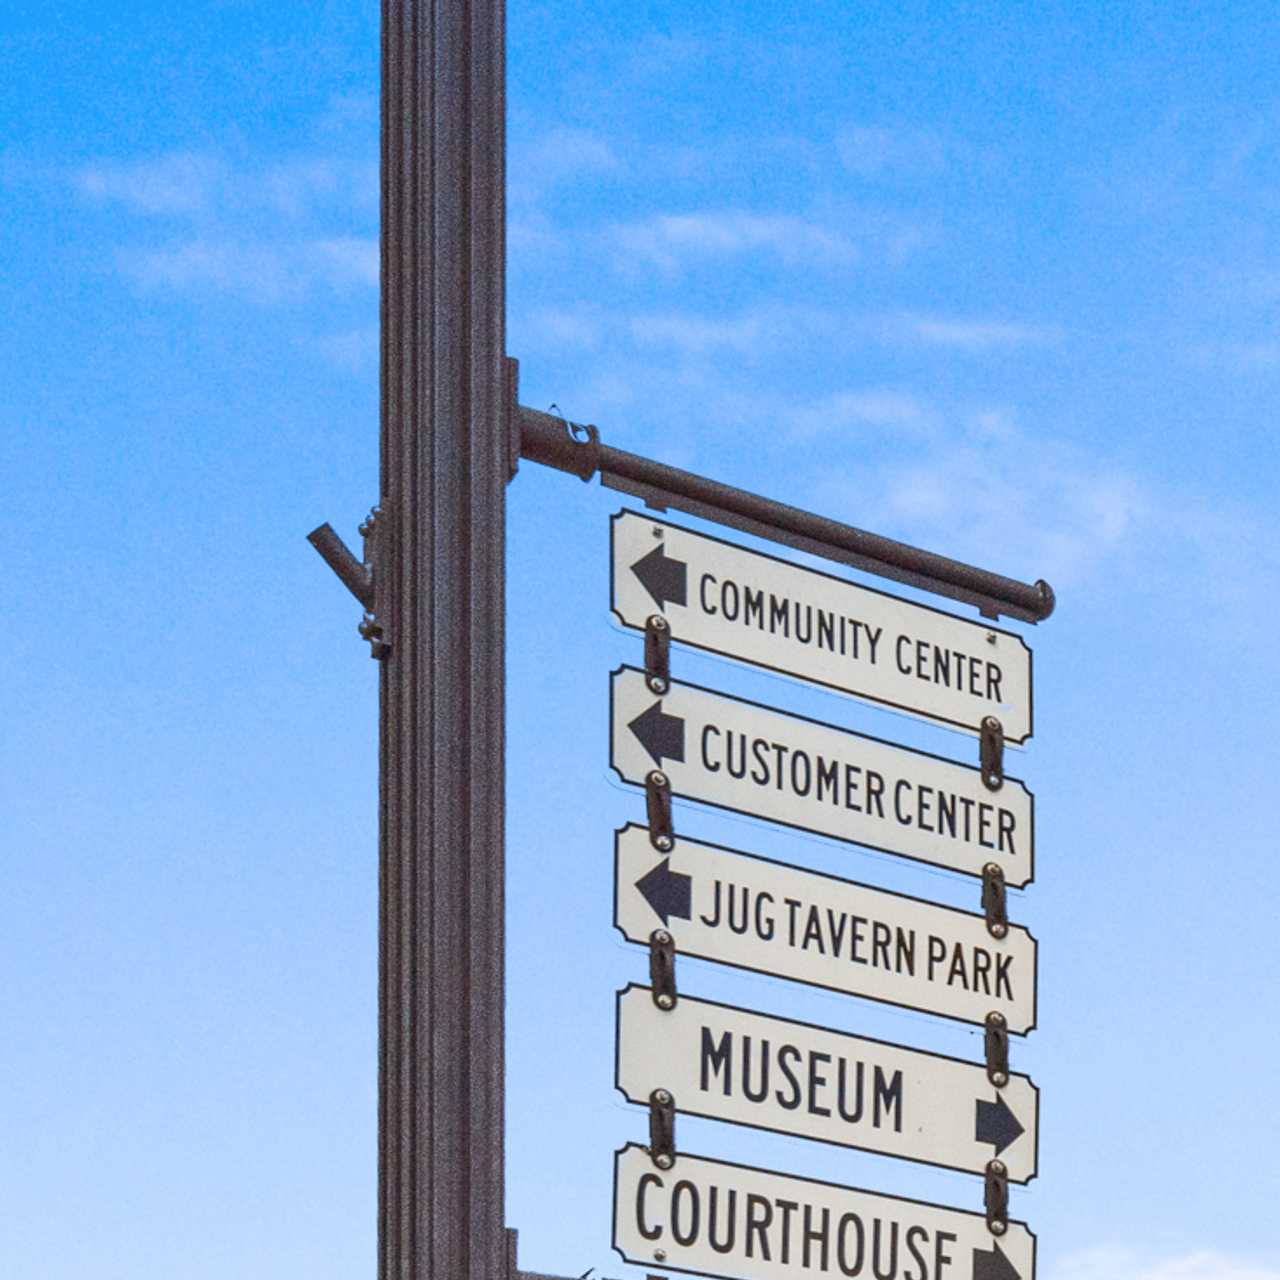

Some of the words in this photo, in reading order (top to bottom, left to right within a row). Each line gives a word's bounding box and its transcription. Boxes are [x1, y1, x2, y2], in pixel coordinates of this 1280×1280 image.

[700, 573, 882, 664] COMMUNITY
[895, 634, 1003, 703] CENTER
[701, 724, 885, 818] CUSTOMER
[894, 780, 1016, 855] CENTER
[700, 880, 775, 942] JUG
[784, 898, 916, 976] TAVERN
[928, 936, 1014, 1000] PARK
[699, 1026, 904, 1133] MUSEUM
